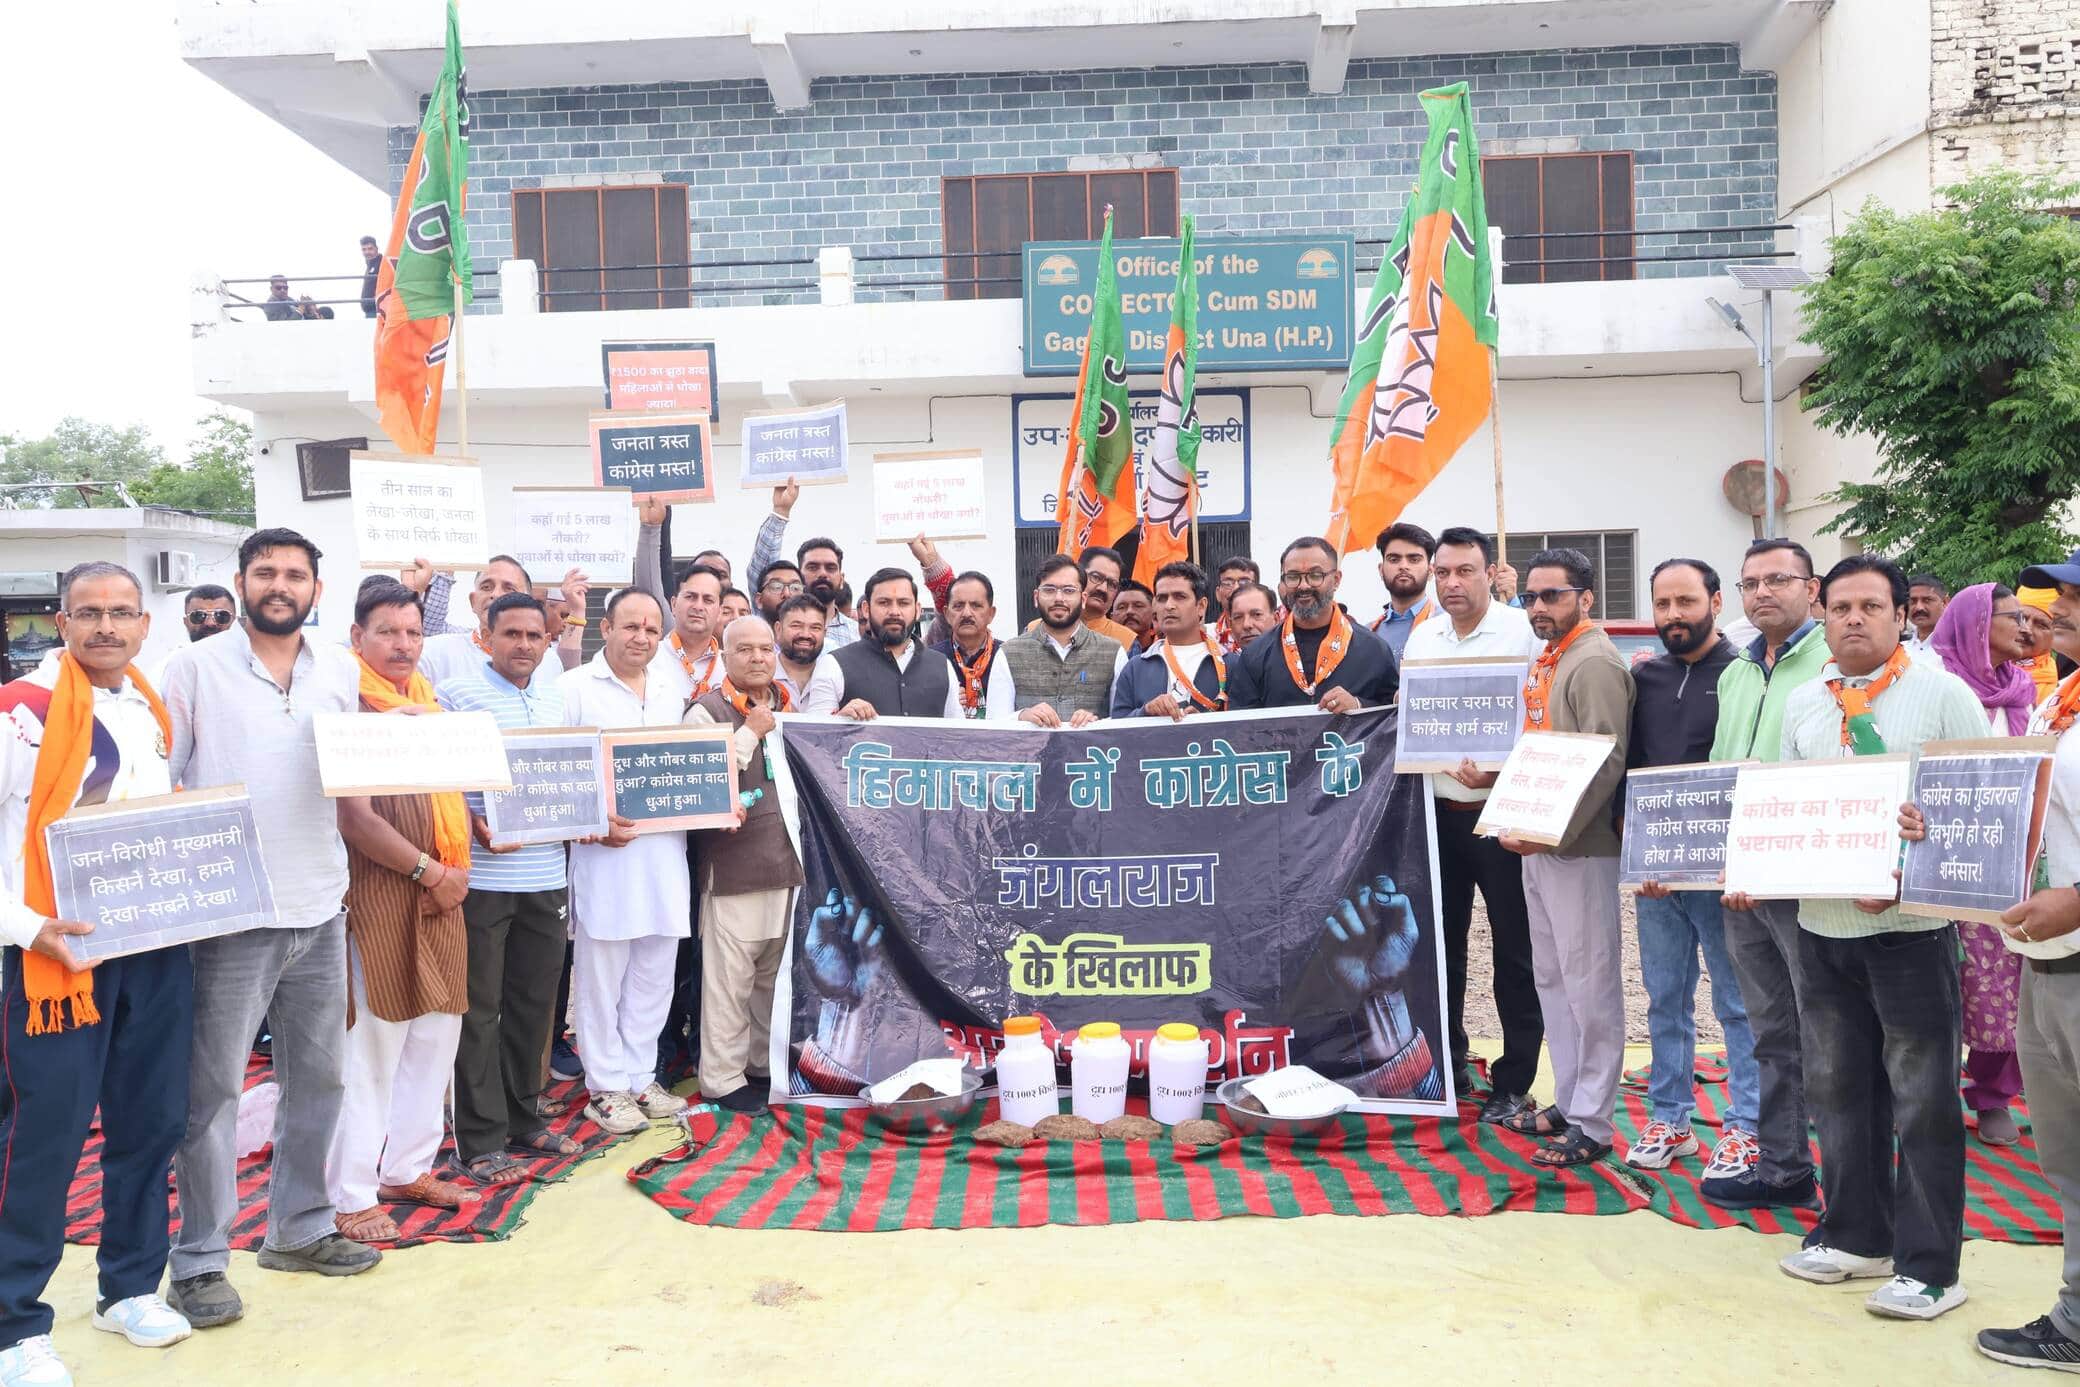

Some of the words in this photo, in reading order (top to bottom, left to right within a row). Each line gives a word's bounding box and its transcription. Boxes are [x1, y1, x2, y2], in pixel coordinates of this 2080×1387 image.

[1117, 256, 1180, 277] Office
[1194, 255, 1214, 275] of
[1222, 255, 1259, 274] the
[1208, 290, 1258, 312] Cum
[1267, 289, 1317, 310] SDM
[1222, 327, 1267, 348] Una
[1275, 326, 1334, 351] (H.P.)
[611, 435, 655, 452] जनता
[659, 434, 690, 450] त्रस्त
[760, 427, 800, 441] जनता
[801, 424, 832, 438] त्रस्त
[755, 446, 798, 464] कांग्रेस
[800, 445, 835, 460] मस्त!
[608, 459, 655, 480] कांग्रेस
[658, 459, 696, 477] मस्त!
[380, 480, 403, 497] तीन
[407, 485, 433, 497] साल
[437, 486, 453, 498] का
[442, 508, 475, 521] जनता
[367, 523, 381, 541] के
[384, 528, 409, 542] साथ
[567, 549, 597, 563] धोखा
[1409, 696, 1459, 711] भ्रष्टाचार
[1462, 695, 1493, 710] चरम
[1495, 695, 1515, 710] पर
[1411, 717, 1452, 737] कांग्रेस
[1455, 717, 1480, 736] शर्म
[1482, 720, 1508, 736] कर!
[511, 758, 532, 775] और
[532, 756, 558, 773] गोबर
[559, 760, 573, 773] का
[575, 759, 593, 771] क्या
[612, 757, 632, 774] दूध
[634, 752, 657, 768] और
[658, 751, 687, 767] गोबर
[688, 753, 705, 765] का
[707, 752, 728, 764] क्या
[841, 741, 1042, 813] हिमाचल
[1064, 746, 1122, 812] में
[1140, 738, 1292, 809] कांग्रेस
[1315, 731, 1365, 798] के
[527, 779, 558, 796] कांग्रेस
[559, 781, 574, 793] का
[576, 780, 598, 793] वादा
[614, 775, 647, 794] हुआ?
[649, 771, 684, 788] कांग्रेस
[686, 773, 702, 785] का
[704, 772, 729, 785] वादा
[645, 792, 671, 812] धुआं
[1636, 789, 1674, 813] हज़ारों
[1675, 788, 1721, 807] संस्थान
[1741, 796, 1796, 819] कांग्रेस
[1800, 799, 1830, 818] का
[1921, 781, 1953, 807] कांग्रेस
[1954, 787, 1973, 807] का
[1973, 782, 2021, 813] गुंडाराज
[523, 802, 547, 822] धुआं
[1646, 816, 1683, 837] कांग्रेस
[1928, 817, 1966, 849] देवभूमि
[1966, 817, 1981, 848] हो
[1982, 817, 2004, 848] रही
[71, 835, 167, 869] जन-विरोधी
[171, 825, 242, 859] मुख्यमंत्री
[1736, 833, 1806, 852] भ्रष्टाचार
[1811, 827, 1832, 850] के
[1836, 830, 1889, 851] साथ!
[1643, 844, 1671, 867] होश
[1673, 843, 1686, 864] में
[88, 871, 144, 899] किसने
[148, 867, 193, 888] देखा,
[196, 856, 236, 884] हमने
[992, 842, 1220, 909] जंगलराज
[1939, 854, 1984, 883] शर्मसार!
[98, 895, 190, 927] देखा-सबने
[192, 887, 239, 909] देखा!
[1019, 939, 1058, 989] के
[1062, 938, 1201, 989] खिलाफ
